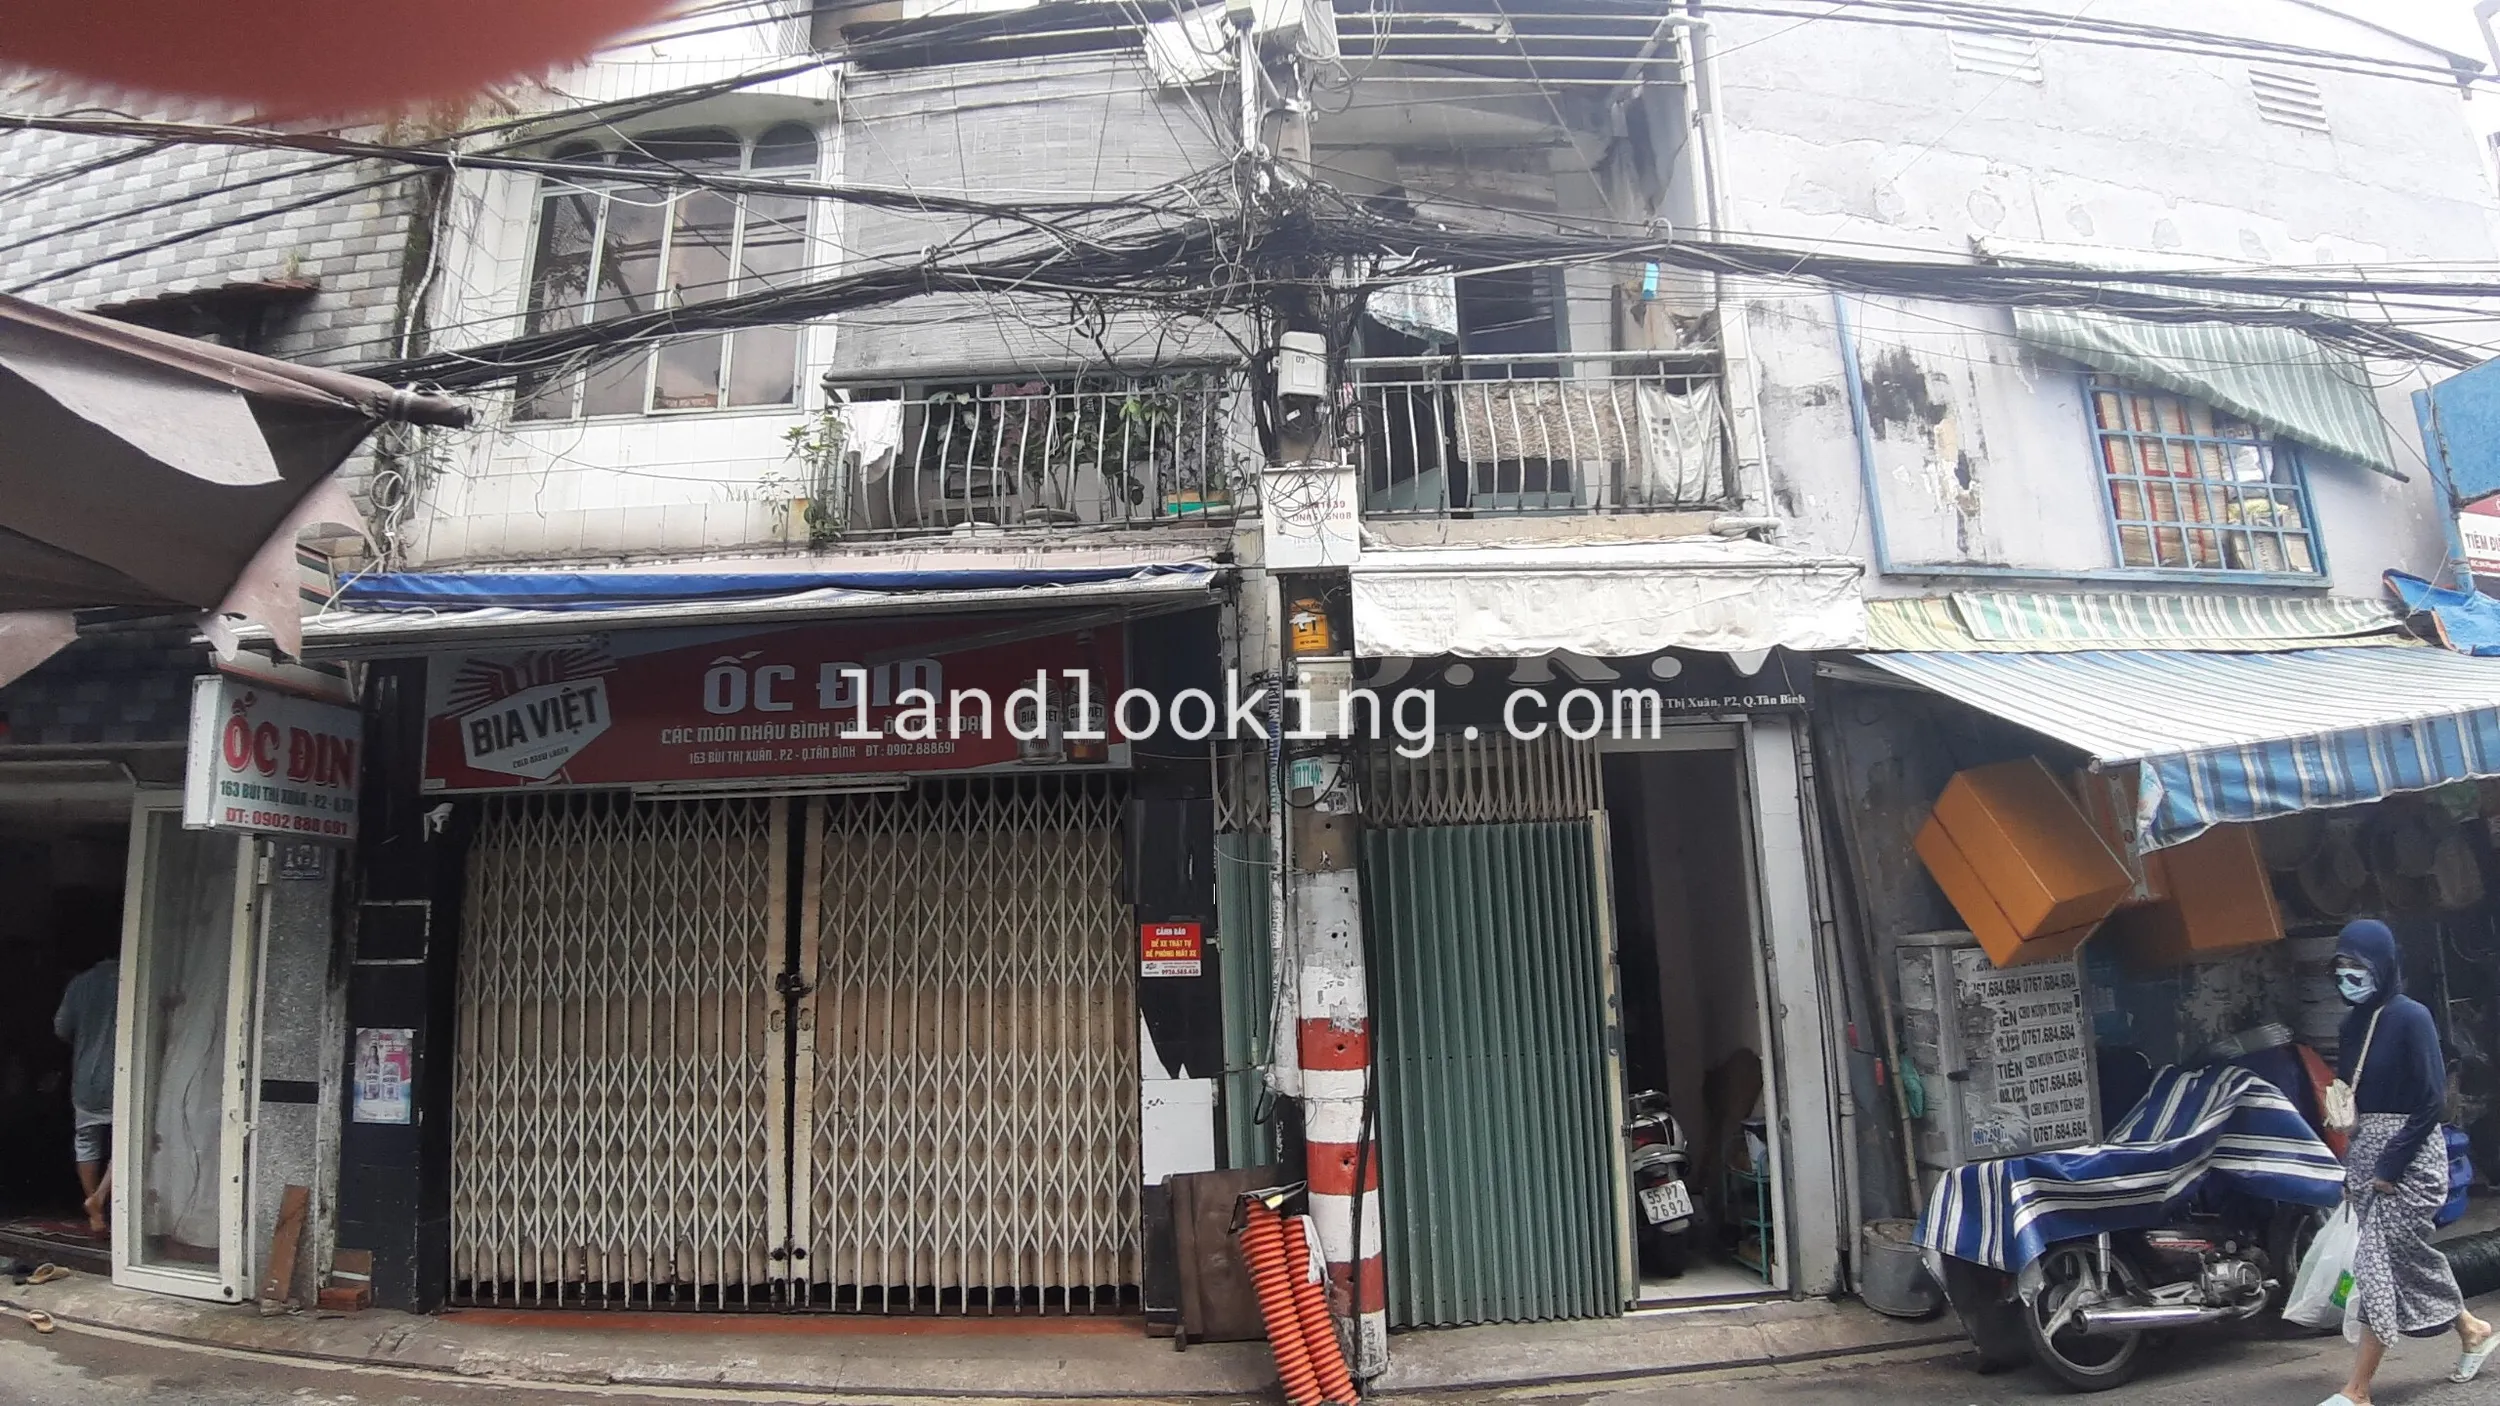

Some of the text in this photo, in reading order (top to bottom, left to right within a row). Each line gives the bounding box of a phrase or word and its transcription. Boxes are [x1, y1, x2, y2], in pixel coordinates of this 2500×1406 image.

[704, 650, 796, 715] ỐC
[1665, 697, 1685, 710] Thị
[469, 686, 598, 757] BIA VIỆT
[661, 725, 693, 745] CÁC
[697, 723, 737, 743] MÓN
[740, 721, 785, 744] NHẬU
[790, 719, 829, 740] BÌNH
[835, 717, 866, 737] DÂ
[223, 690, 281, 778] ỐC
[512, 758, 529, 769] COLD
[708, 748, 725, 764] BÙI
[728, 750, 743, 765] THỊ
[832, 744, 856, 759] BÌNH
[220, 780, 240, 798] 163
[262, 785, 280, 806] THỊ
[252, 809, 290, 829] 0902
[2022, 1024, 2075, 1045] 0767.684.684
[2029, 1070, 2083, 1095] 0767.684.684
[2034, 1120, 2087, 1144] 0767.684.684
[1647, 1185, 1678, 1204] 55-P7
[1652, 1199, 1686, 1220] 7692
